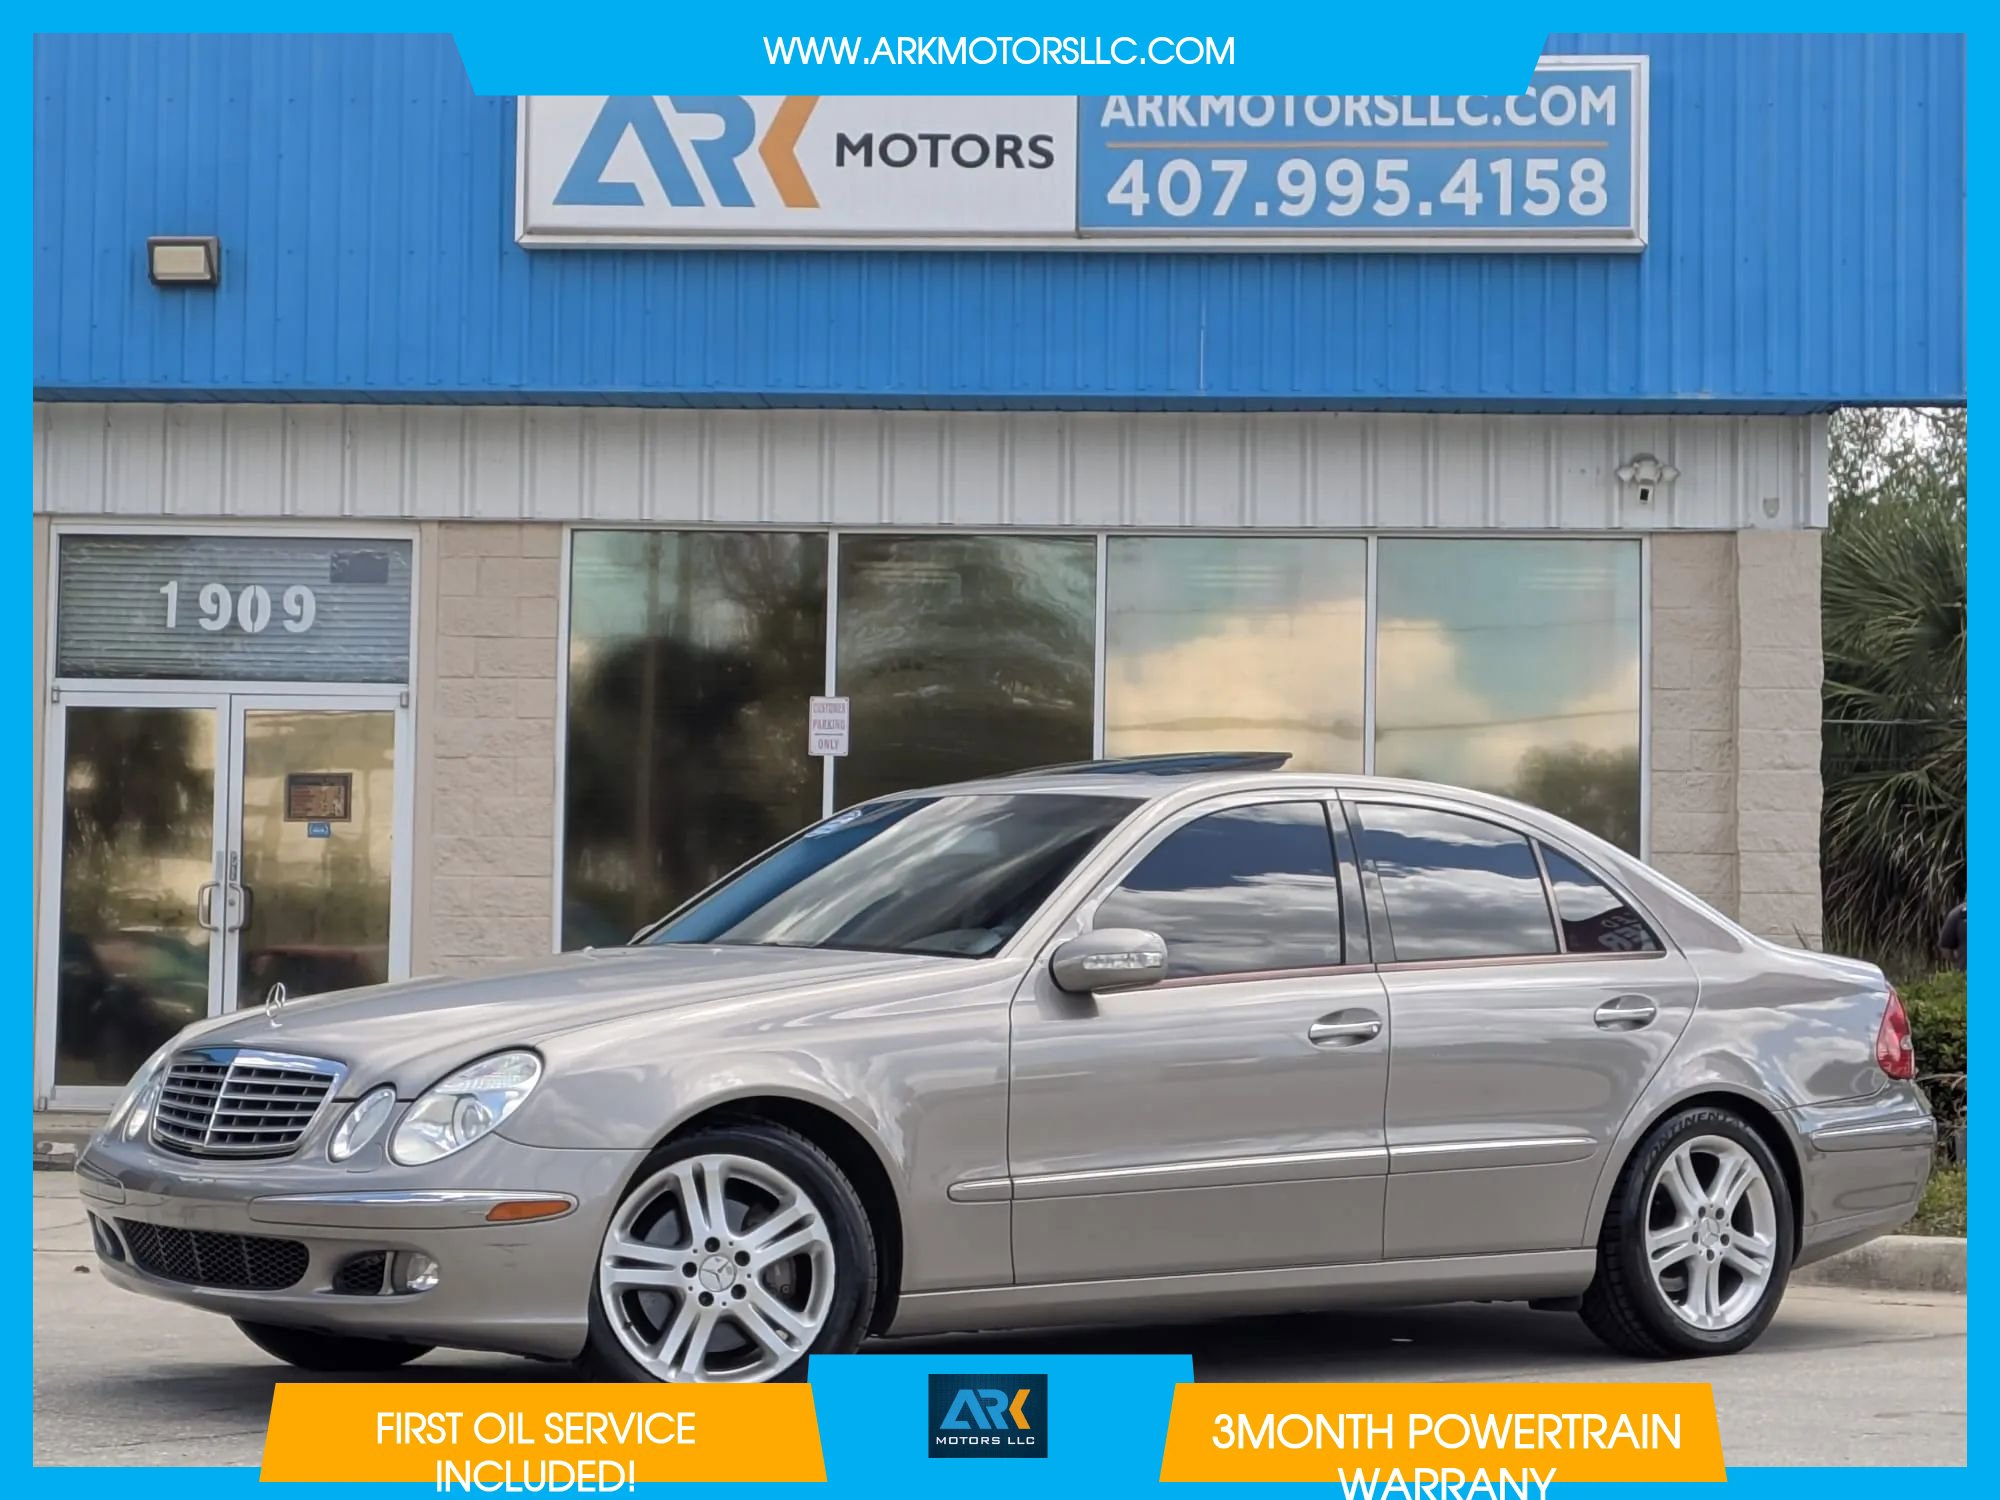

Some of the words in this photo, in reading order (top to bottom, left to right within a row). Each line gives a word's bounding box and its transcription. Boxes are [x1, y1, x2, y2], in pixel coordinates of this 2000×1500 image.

[1100, 85, 1617, 128] ARKMOTORSLLC.COM
[552, 96, 820, 208] ARK
[836, 132, 1054, 169] MOTORS
[1106, 157, 1608, 217] 407.995.4158
[159, 580, 316, 633] 1909
[813, 719, 846, 730] PARKING
[818, 738, 839, 750] ONLY
